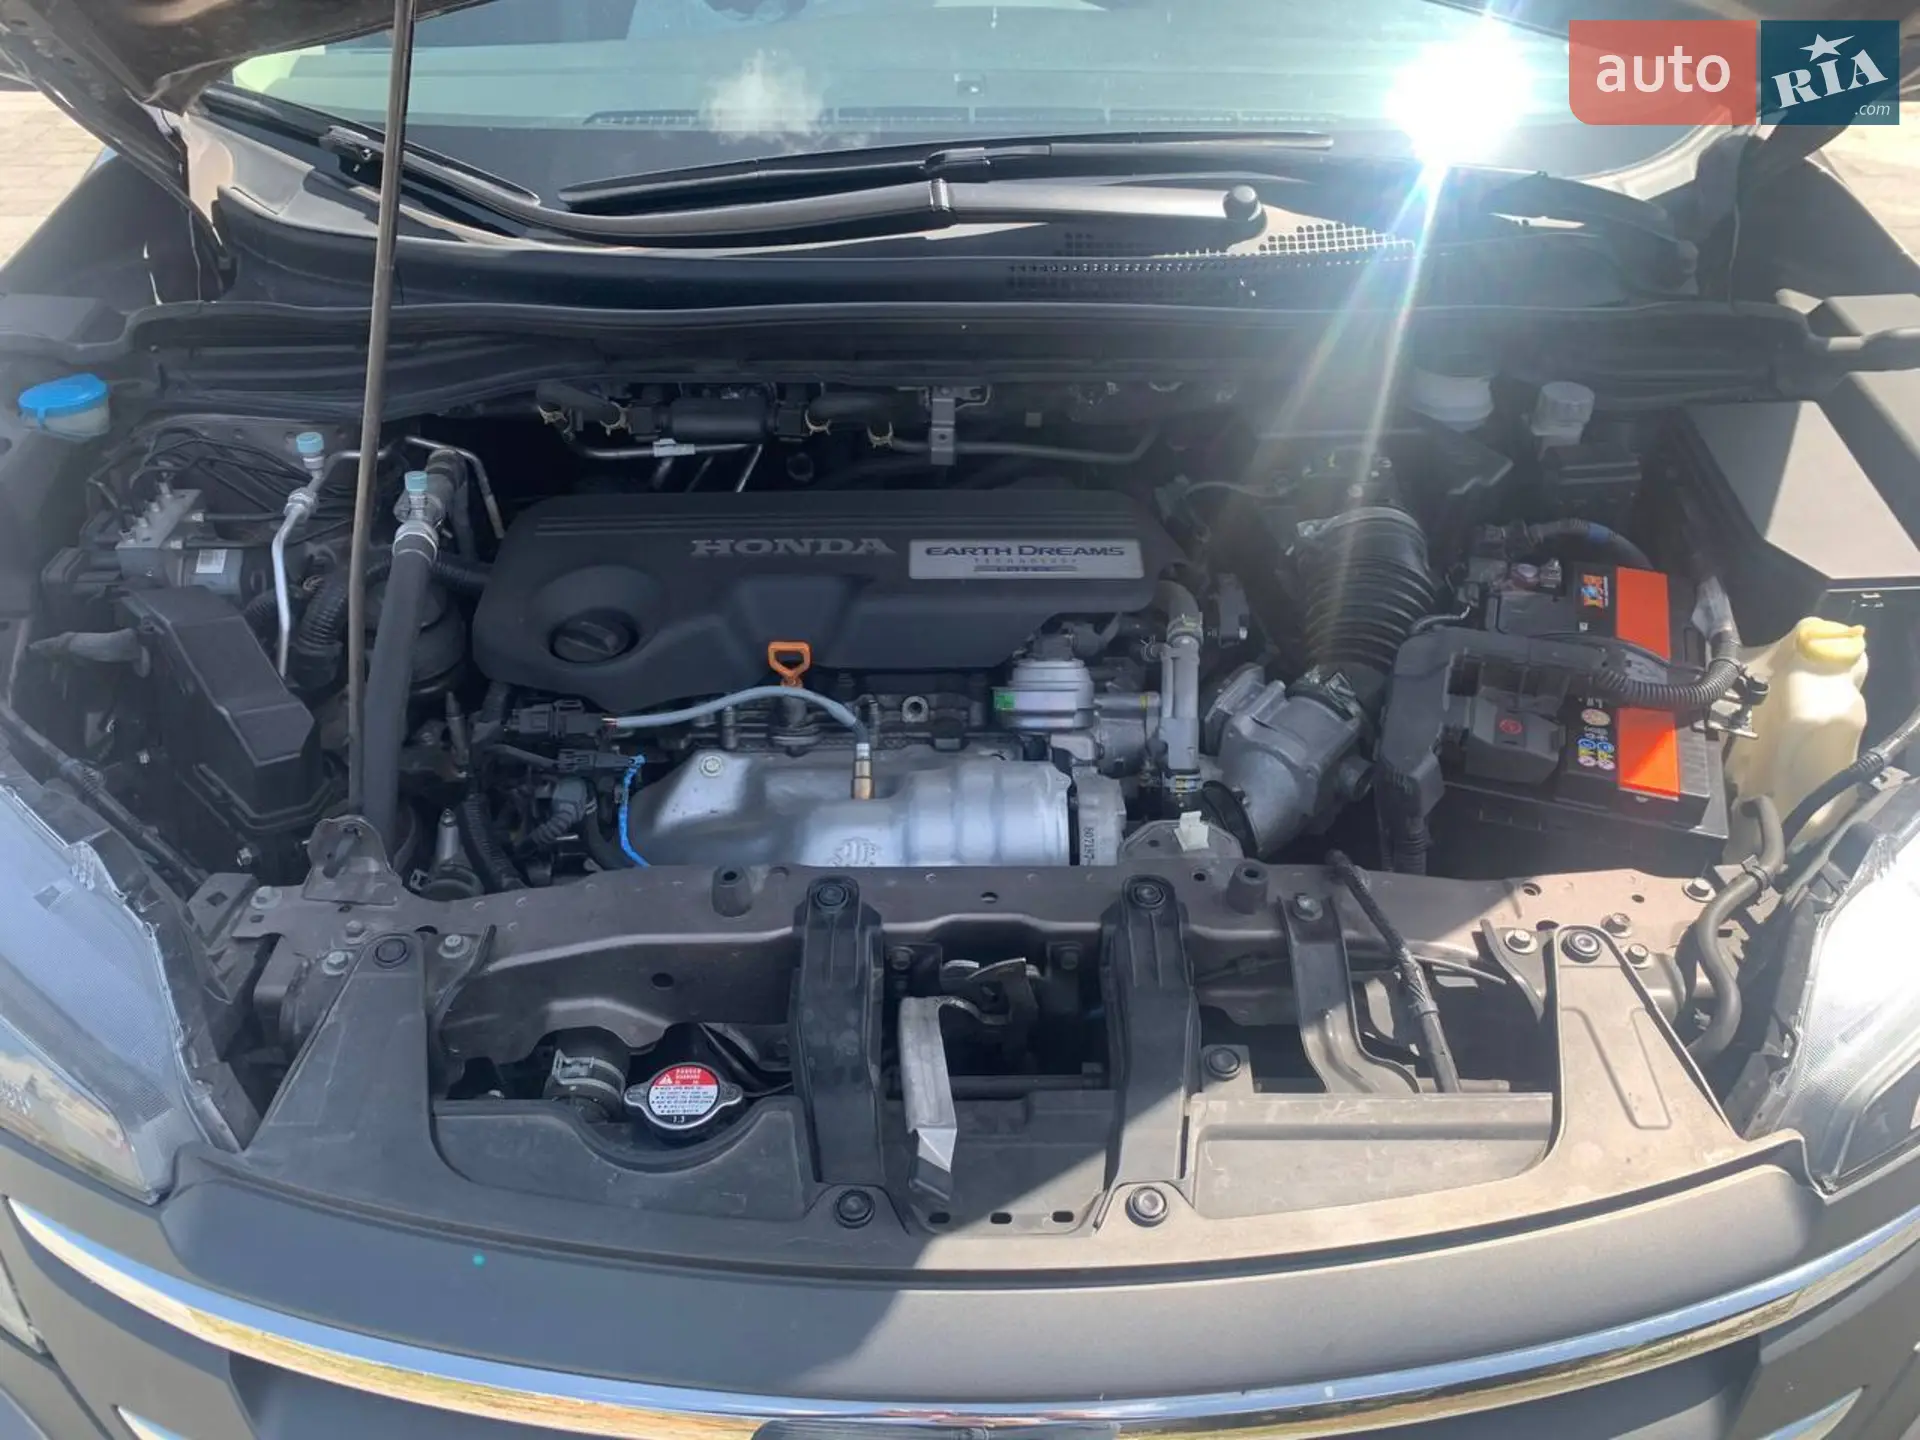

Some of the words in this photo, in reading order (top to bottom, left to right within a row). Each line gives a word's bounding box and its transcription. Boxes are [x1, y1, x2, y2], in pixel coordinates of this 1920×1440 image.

[690, 537, 897, 556] HONDA
[925, 546, 1009, 556] EARTH
[1017, 544, 1125, 556] DREAMS
